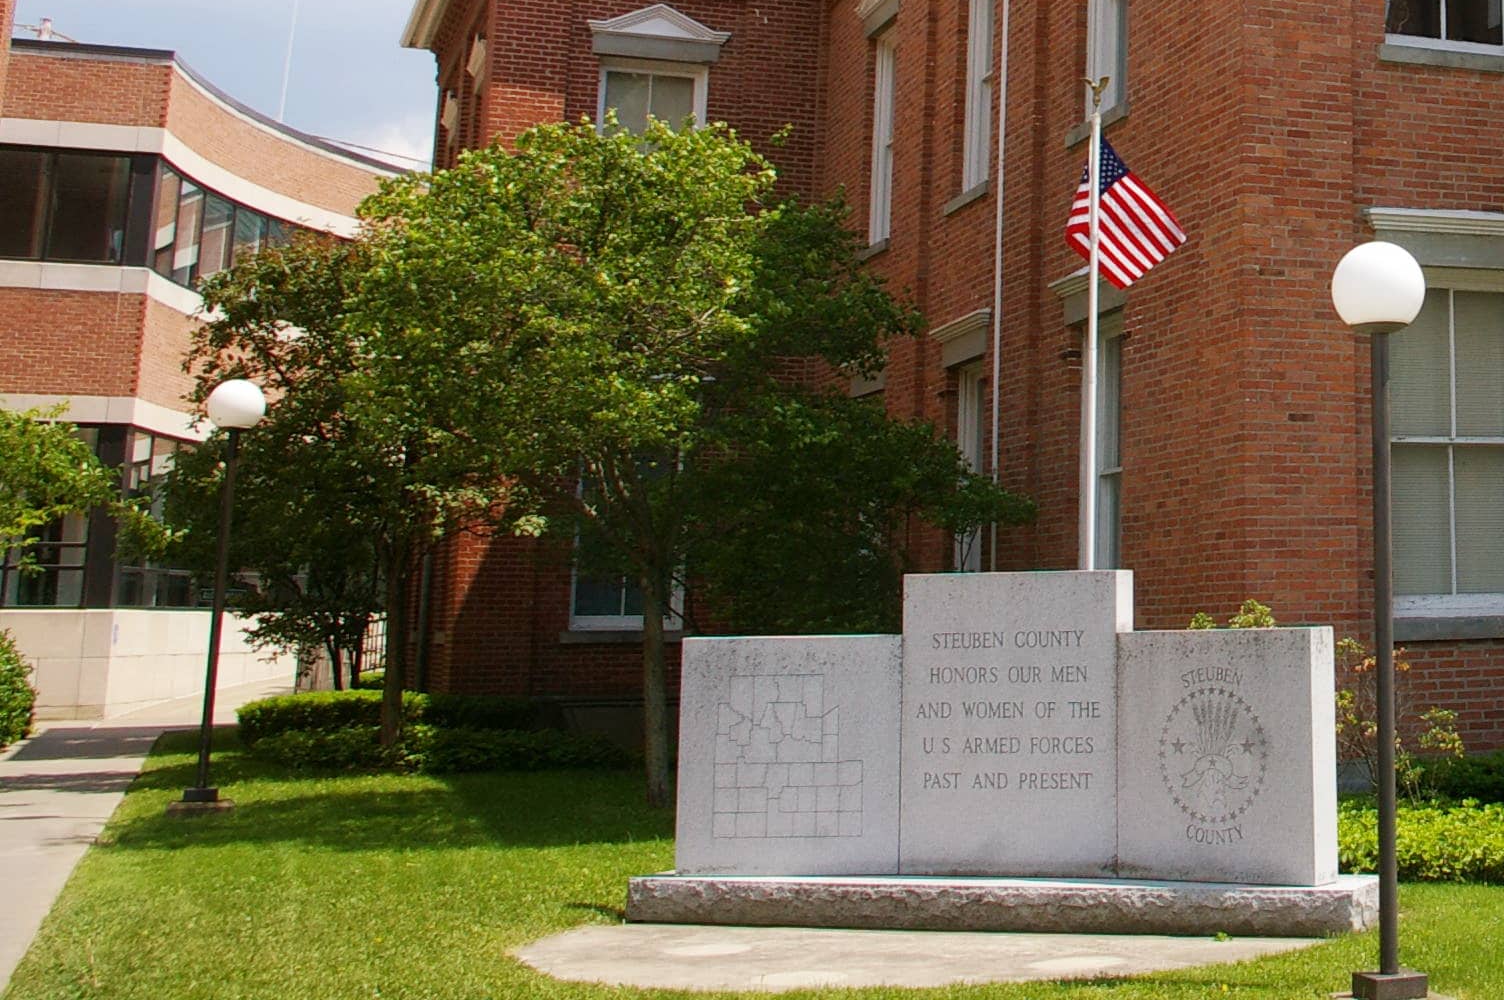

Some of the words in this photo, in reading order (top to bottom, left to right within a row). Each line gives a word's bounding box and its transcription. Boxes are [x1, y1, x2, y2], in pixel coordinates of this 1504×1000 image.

[932, 632, 1004, 649] STEUBEN
[1014, 630, 1085, 648] COUNTY
[929, 666, 998, 684] HONORS
[1008, 665, 1042, 683] OUR
[1051, 665, 1088, 683] MEN
[1181, 666, 1243, 688] STEUBEN
[916, 702, 952, 719] AND
[962, 701, 1024, 719] WOMEN
[1034, 701, 1056, 719] OF
[1068, 701, 1101, 719] THE
[923, 737, 934, 754] U
[942, 737, 951, 754] S
[962, 737, 1021, 754] ARMED
[1030, 736, 1094, 754] FORCES
[923, 772, 962, 789] PAST
[972, 772, 1008, 789] AND
[1019, 772, 1093, 790] PRESENT
[1186, 823, 1244, 845] COUNTY
